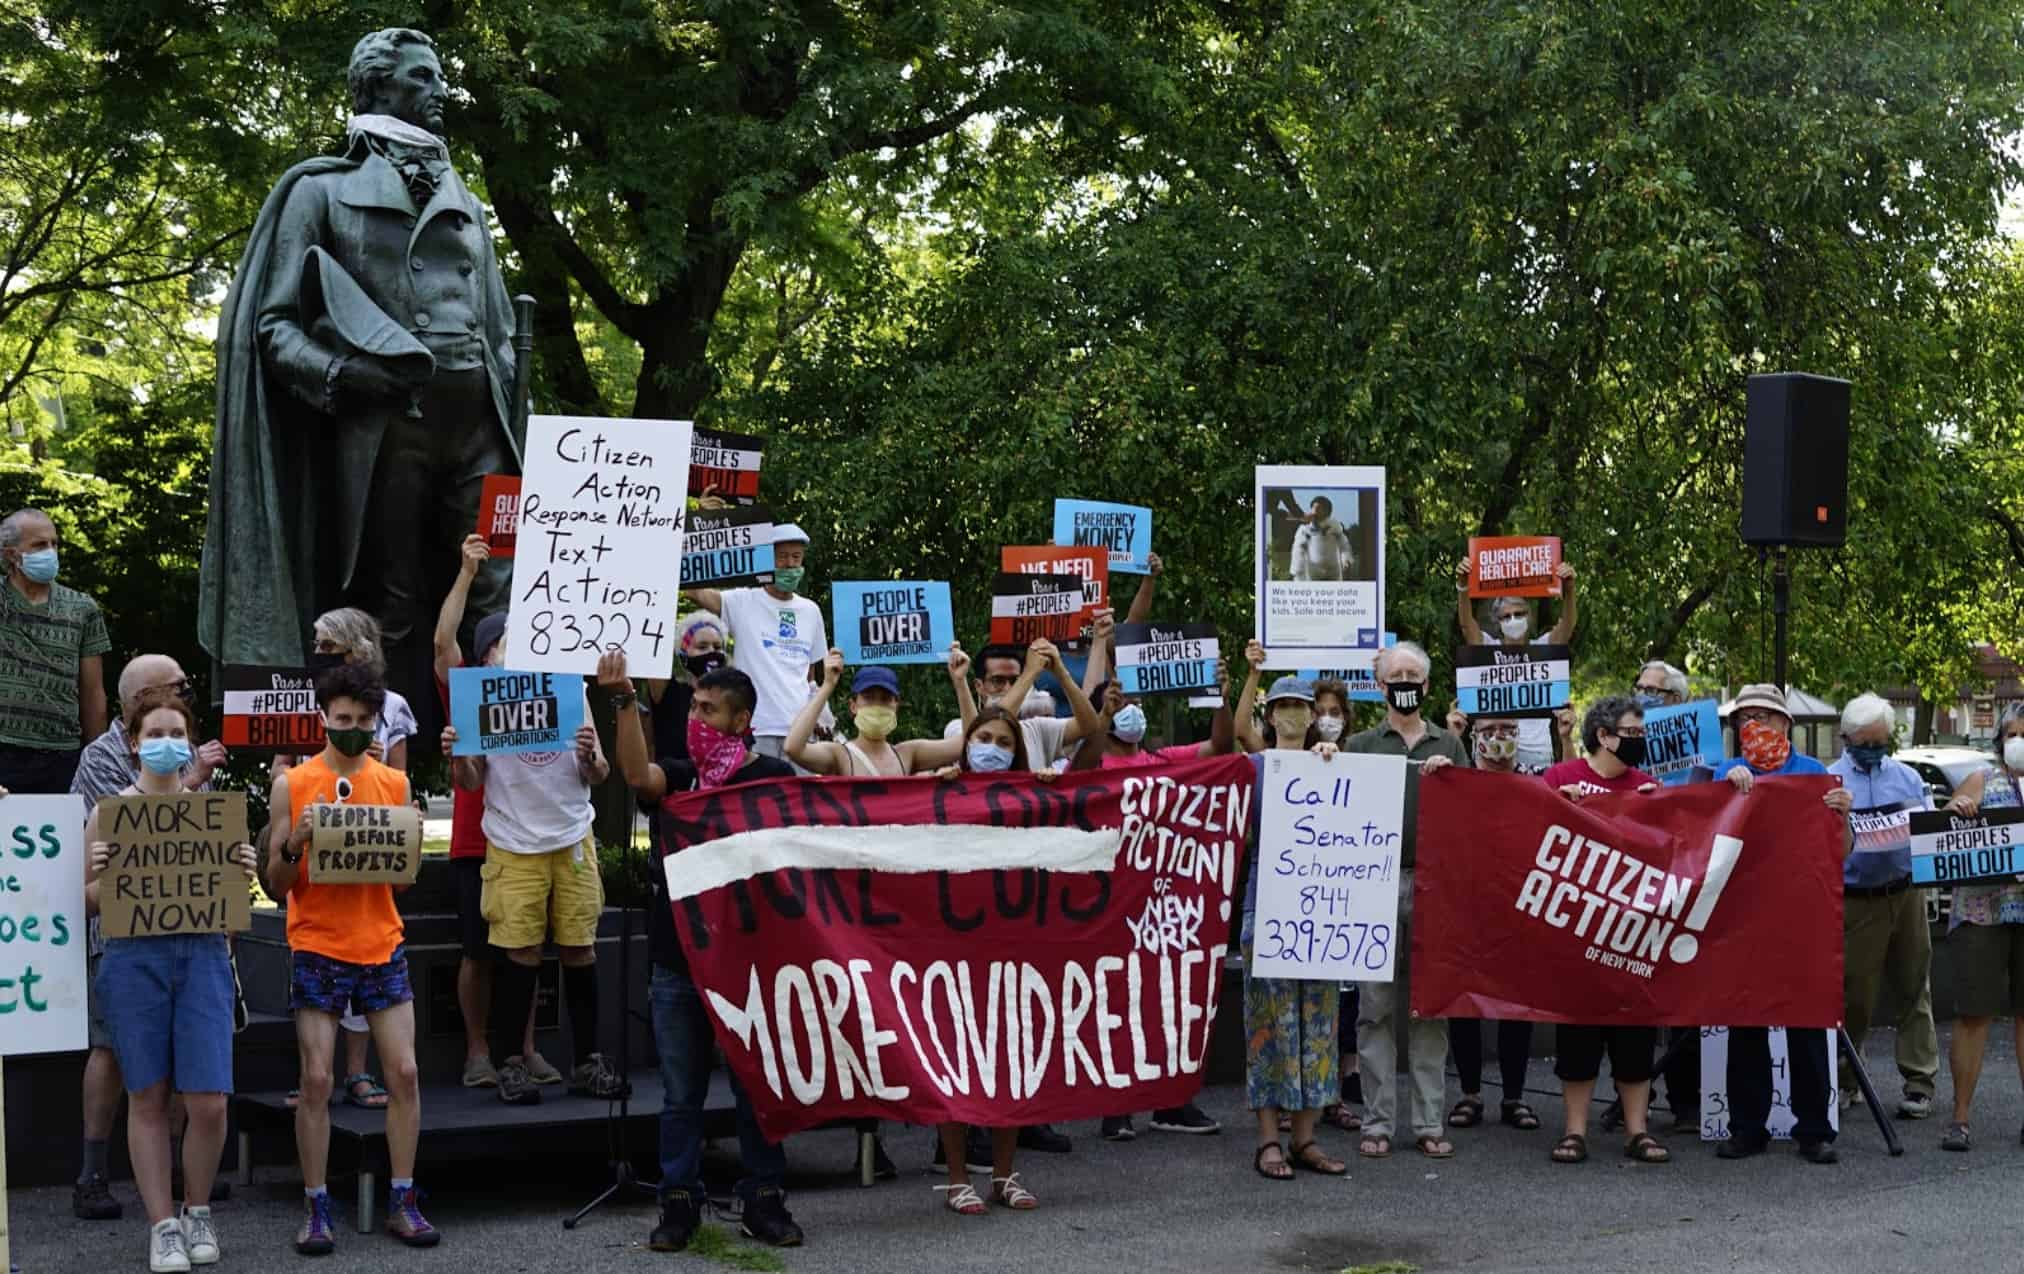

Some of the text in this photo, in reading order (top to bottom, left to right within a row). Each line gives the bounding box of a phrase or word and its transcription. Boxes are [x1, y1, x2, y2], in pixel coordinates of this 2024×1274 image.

[557, 428, 653, 468] Citizen
[691, 447, 740, 468] EOPLE'S
[572, 471, 661, 503] Action
[495, 494, 520, 513] GU
[523, 493, 685, 531] Response Network
[491, 514, 519, 535] HEA
[1074, 511, 1137, 528] EMERGENCY
[546, 530, 613, 565] Text
[1073, 527, 1136, 552] MONEY
[680, 548, 755, 581] BAILOUT
[1479, 544, 1552, 566] GUARANTEE
[1479, 559, 1552, 582] HEALTH CARE
[523, 567, 658, 608] Action:
[862, 587, 927, 616] PEOPLE
[1082, 581, 1101, 604] W!
[530, 610, 664, 657] 83224
[868, 613, 922, 645] OVER
[1138, 640, 1202, 664] #PEOPLE'S
[481, 672, 554, 703] PEOPLE
[1137, 661, 1205, 691] BAILOUT
[1480, 663, 1549, 685] #PEOPLE'S
[1393, 690, 1418, 708] VOTE
[1477, 683, 1553, 713] BAILOUT
[248, 715, 327, 745] BAILOU
[488, 699, 549, 735] OVER
[1645, 710, 1699, 738] ERGENCY
[480, 729, 560, 751] CORPORATIONS!
[1120, 775, 1252, 839] CITIZEN
[1285, 777, 1351, 808] Call
[113, 798, 226, 834] MORE
[318, 805, 390, 828] PEOPLE
[1294, 815, 1400, 847] Senator
[0, 824, 61, 859] ss
[344, 829, 406, 848] BEFORE
[1936, 827, 2010, 852] #PEOPLE'S
[105, 840, 243, 870] PANDEMIC
[318, 849, 408, 872] PROFITS
[1119, 813, 1235, 922] ACTION!
[1274, 849, 1393, 882] Schumer!!
[1933, 847, 2016, 880] BAILOUT
[116, 871, 221, 900] RELIEF
[1153, 877, 1173, 896] OF
[1535, 824, 1692, 920] CITIZEN
[1145, 892, 1204, 927] NEW
[1300, 886, 1349, 916] 844
[130, 898, 227, 935] NOW!
[1126, 916, 1201, 957] YORK
[1258, 919, 1390, 970] 329-7578
[1585, 945, 1655, 978] OF NEW YORK
[704, 943, 1228, 1105] MORE COVID RELIEF
